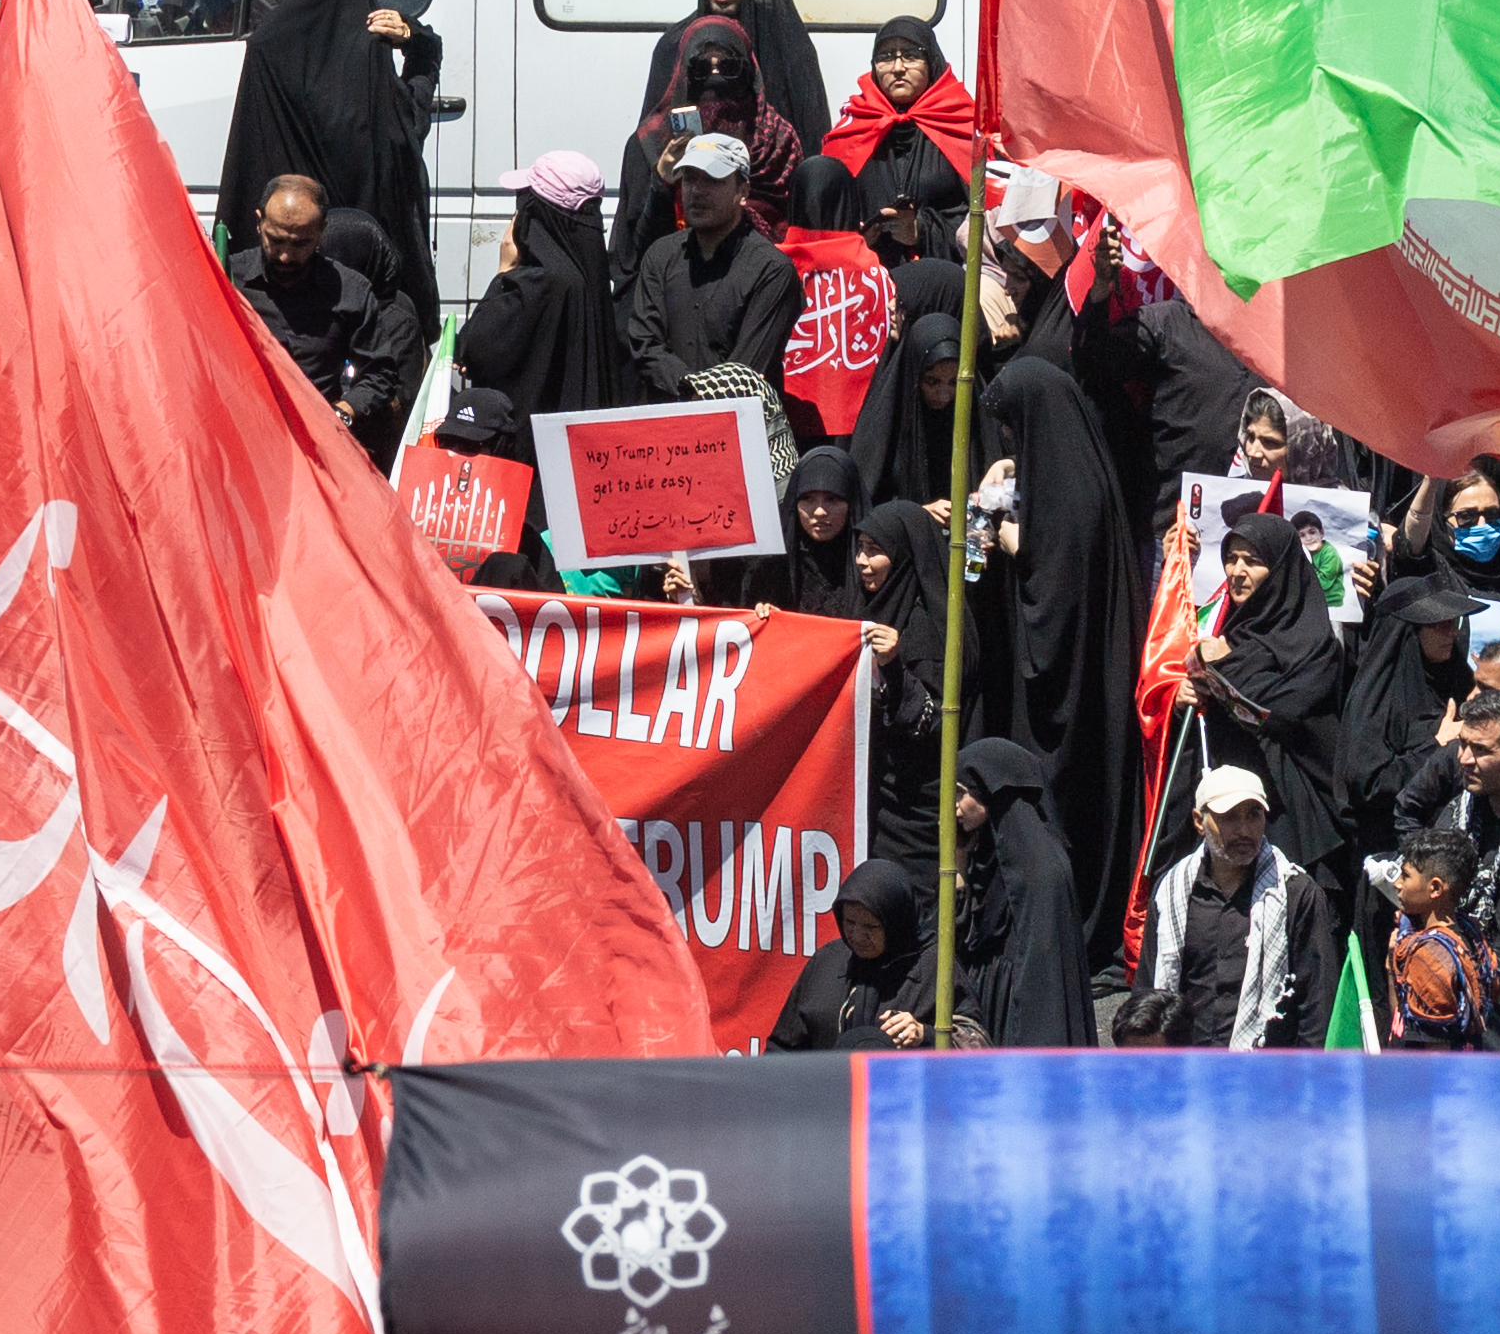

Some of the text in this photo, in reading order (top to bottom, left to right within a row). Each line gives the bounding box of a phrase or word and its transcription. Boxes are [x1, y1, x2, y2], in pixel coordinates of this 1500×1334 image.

[587, 440, 727, 470] Hey Trump! you don't
[593, 479, 614, 504] get
[617, 477, 630, 492] to
[635, 474, 654, 490] die
[642, 511, 677, 530] راحت
